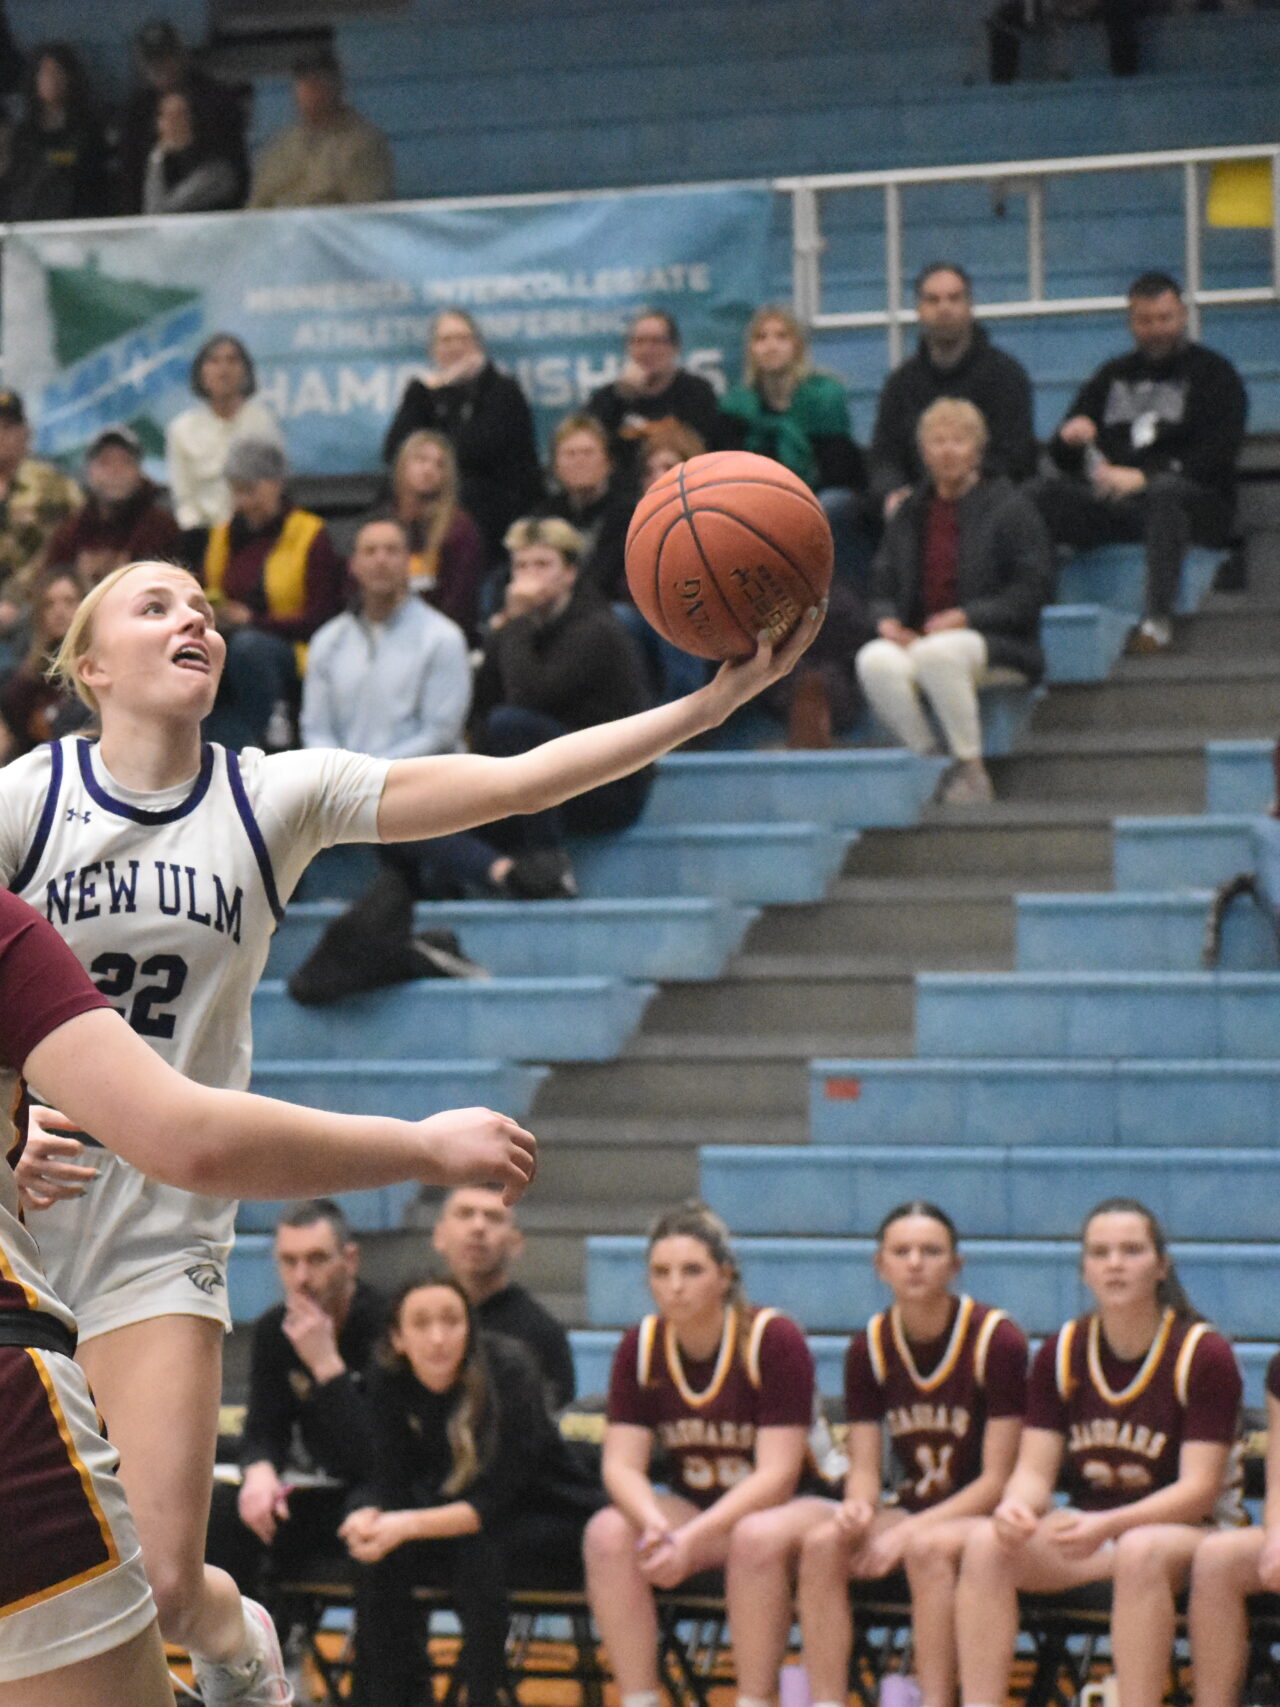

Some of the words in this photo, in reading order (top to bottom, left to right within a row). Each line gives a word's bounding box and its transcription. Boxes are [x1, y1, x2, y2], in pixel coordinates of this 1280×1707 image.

[424, 265, 711, 302] INTERCOLLEGIATE
[46, 860, 140, 926] NEW
[154, 861, 244, 945] ULM
[91, 952, 188, 1040] 22
[1069, 1418, 1168, 1459] JAGUARS
